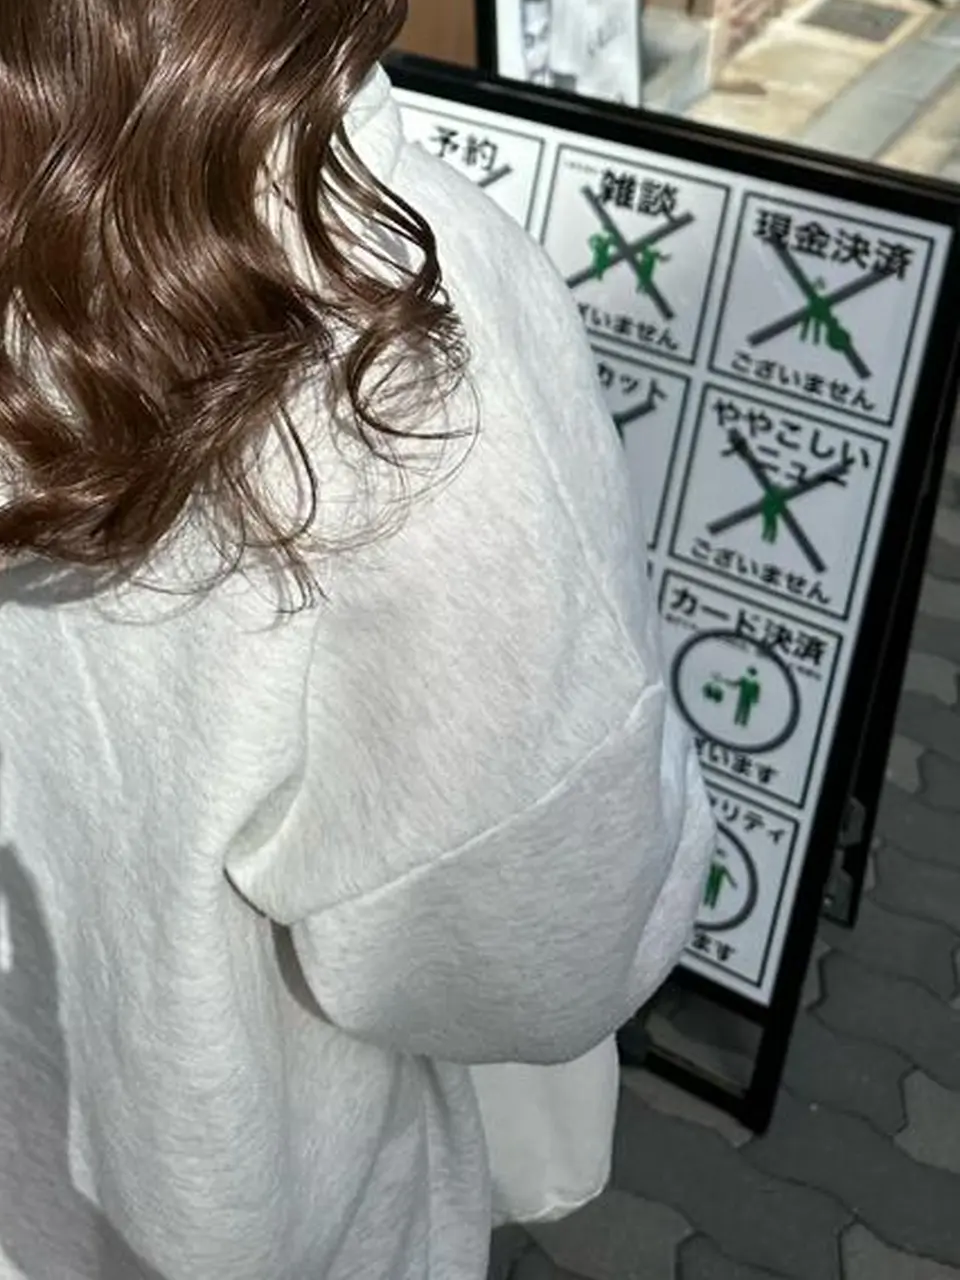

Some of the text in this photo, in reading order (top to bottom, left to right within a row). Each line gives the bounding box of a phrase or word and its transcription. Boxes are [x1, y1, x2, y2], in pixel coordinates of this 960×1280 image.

[430, 125, 498, 170] 予約
[599, 167, 679, 222] 雑談
[754, 208, 916, 281] 現金決済
[731, 350, 876, 411] ございません
[713, 397, 870, 469] ややこしい
[692, 537, 831, 604] ございません
[670, 589, 828, 666] カード決済
